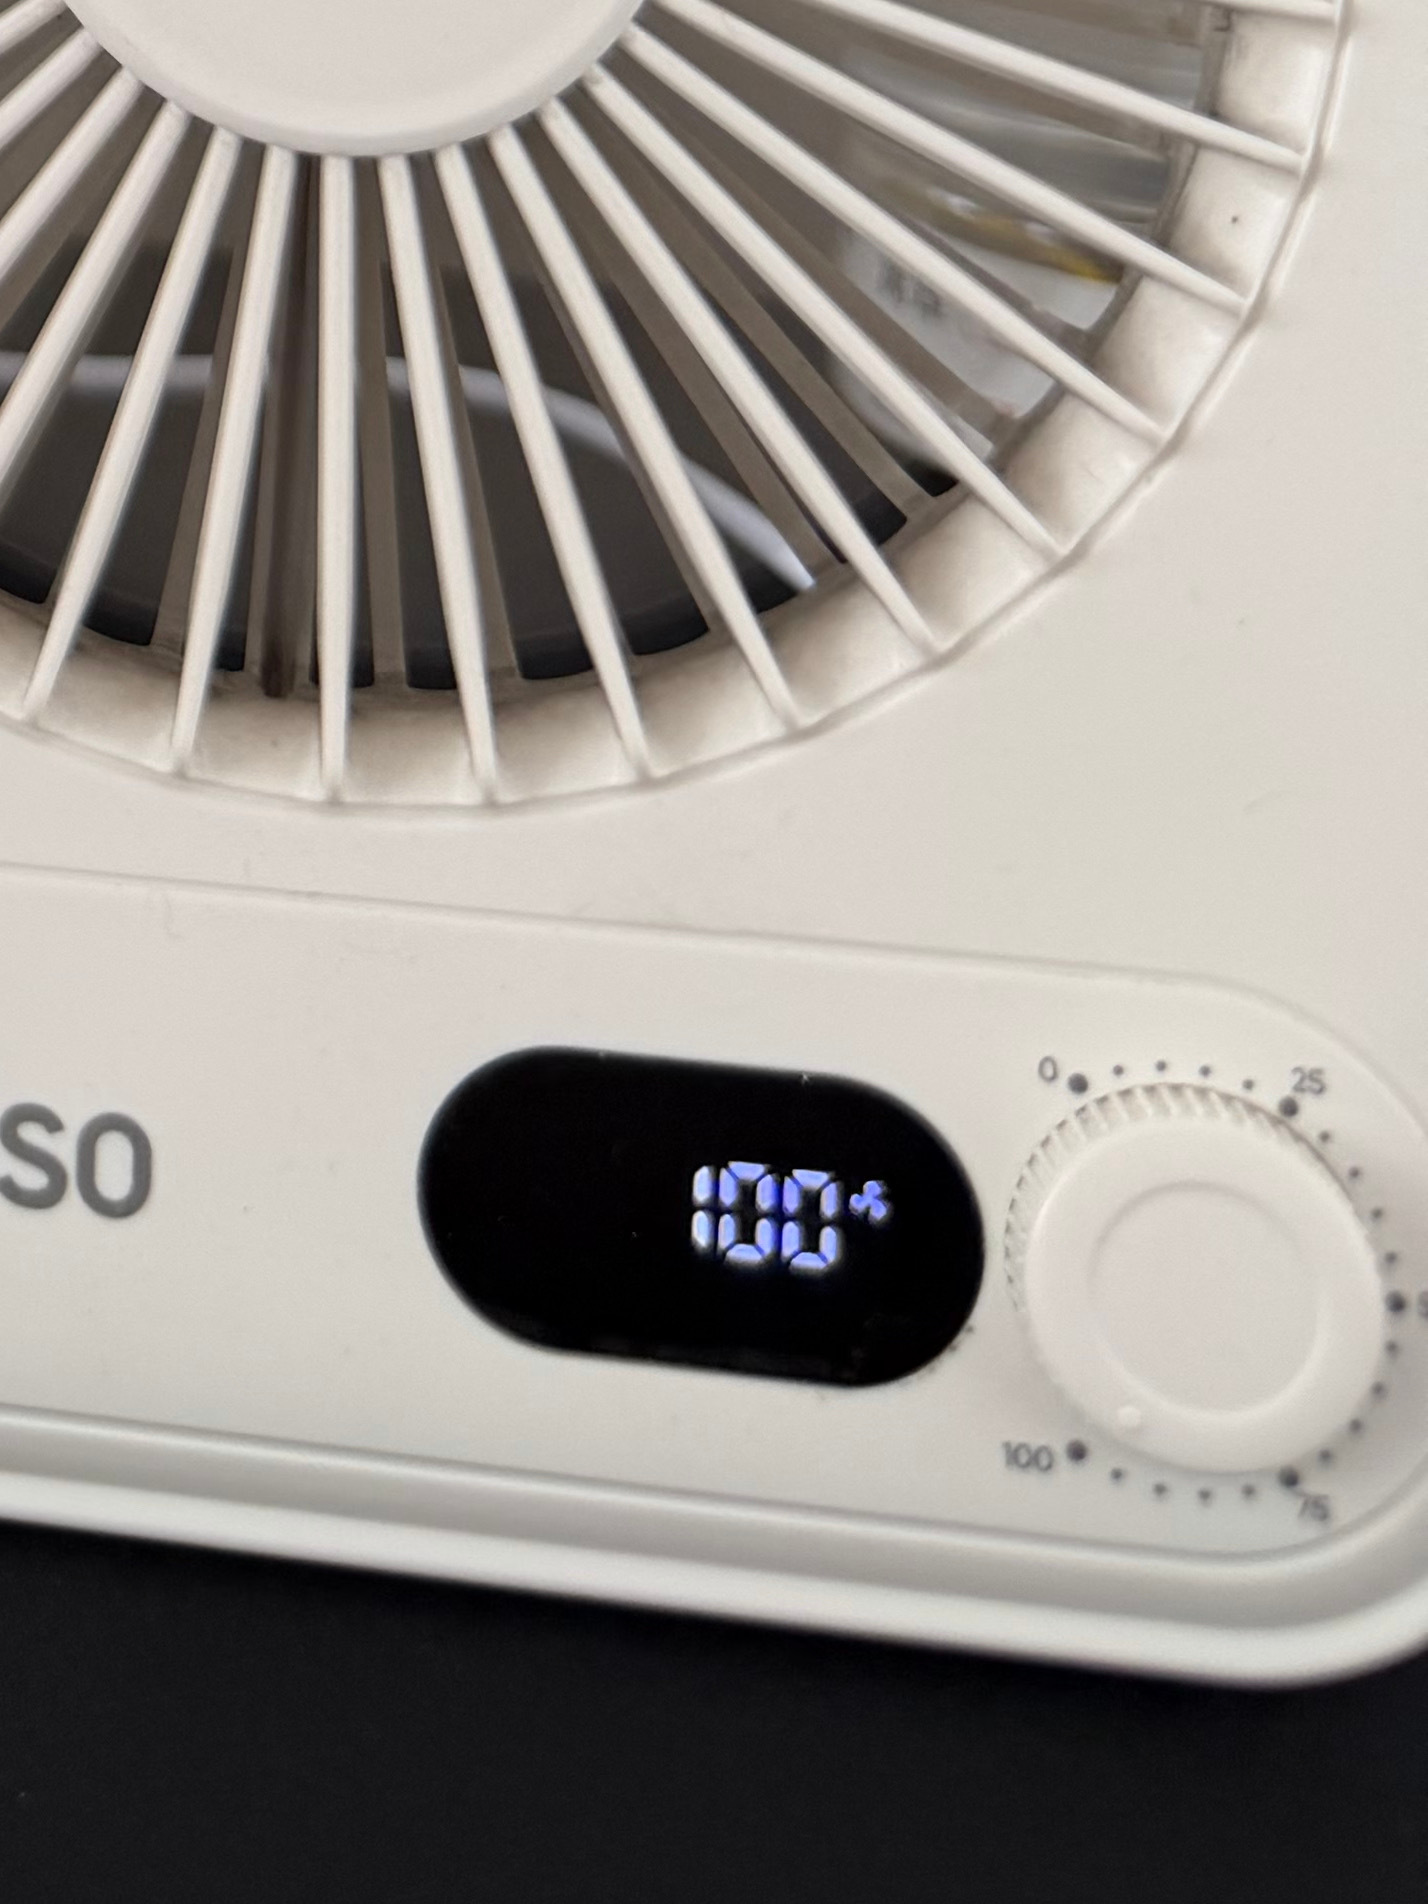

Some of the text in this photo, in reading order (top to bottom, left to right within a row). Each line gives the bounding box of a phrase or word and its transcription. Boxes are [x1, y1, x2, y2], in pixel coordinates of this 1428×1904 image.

[1037, 1056, 1326, 1094] 0 25
[693, 1160, 841, 1272] 100
[1002, 1441, 1054, 1471] 100
